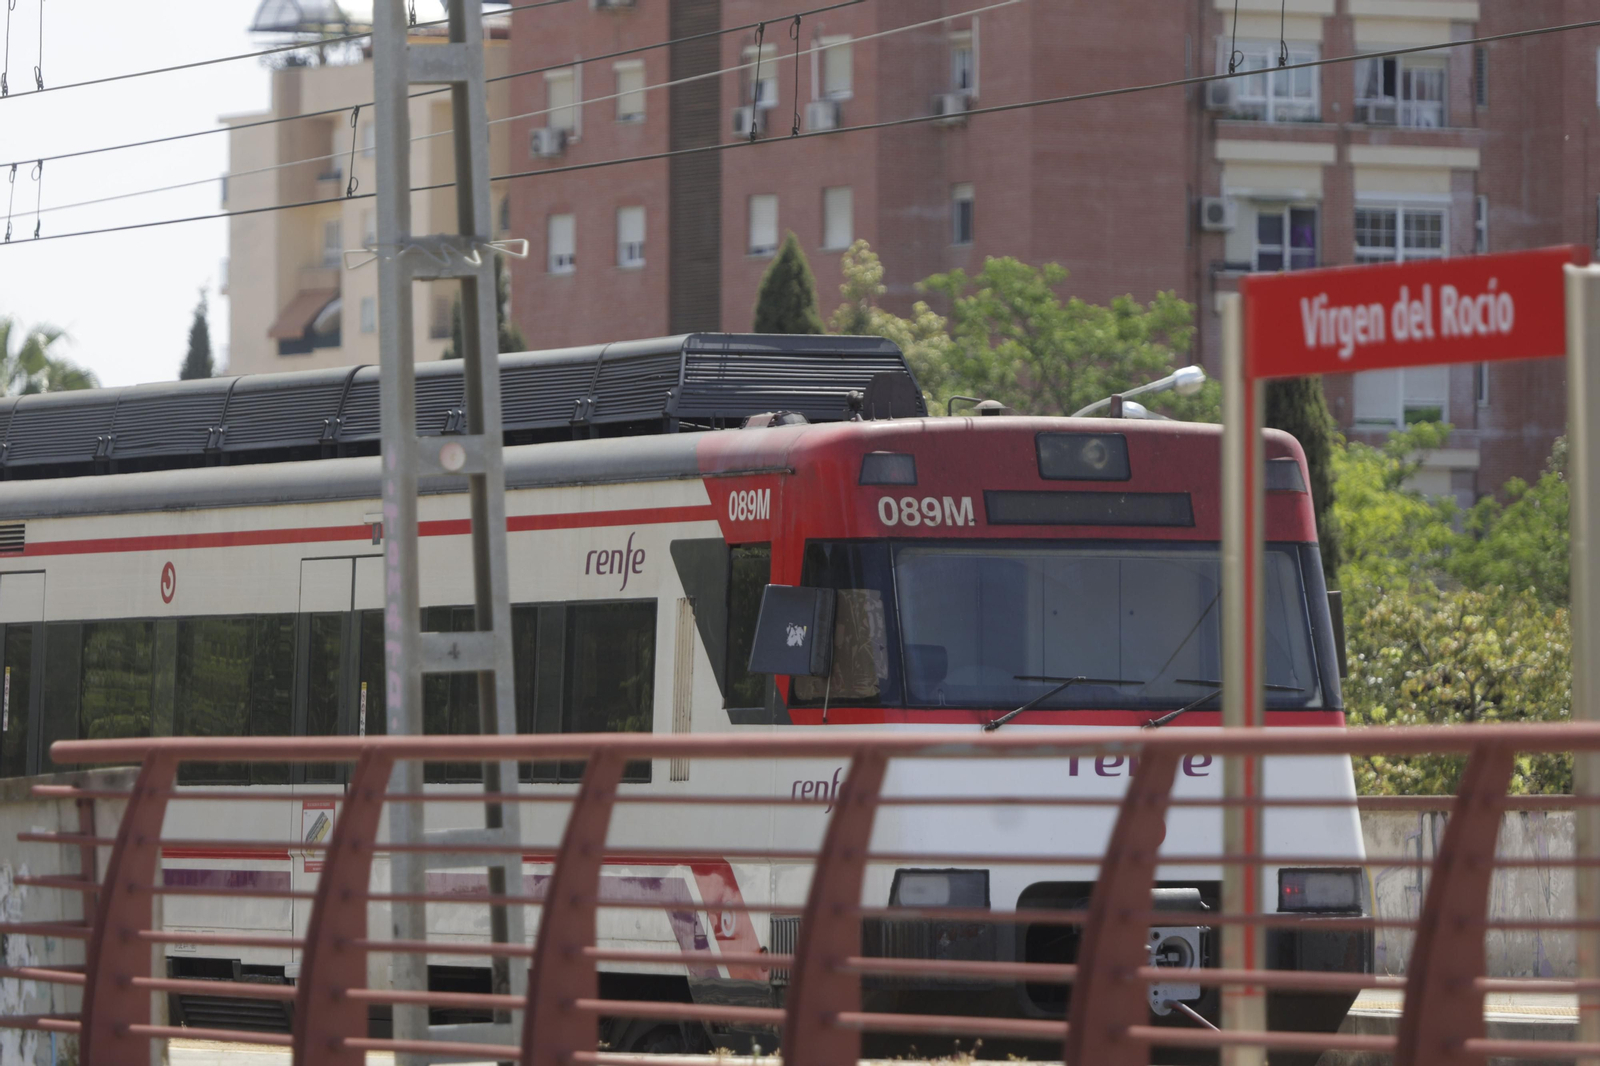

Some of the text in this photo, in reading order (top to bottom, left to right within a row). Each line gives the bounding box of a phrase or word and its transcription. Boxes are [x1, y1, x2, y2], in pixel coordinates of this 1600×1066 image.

[1301, 277, 1514, 360] Virgen del Rocío
[728, 489, 771, 521] 089M
[878, 496, 975, 526] 089M
[585, 531, 646, 591] renfe
[1068, 752, 1213, 777] ree
[791, 767, 847, 814] renf
